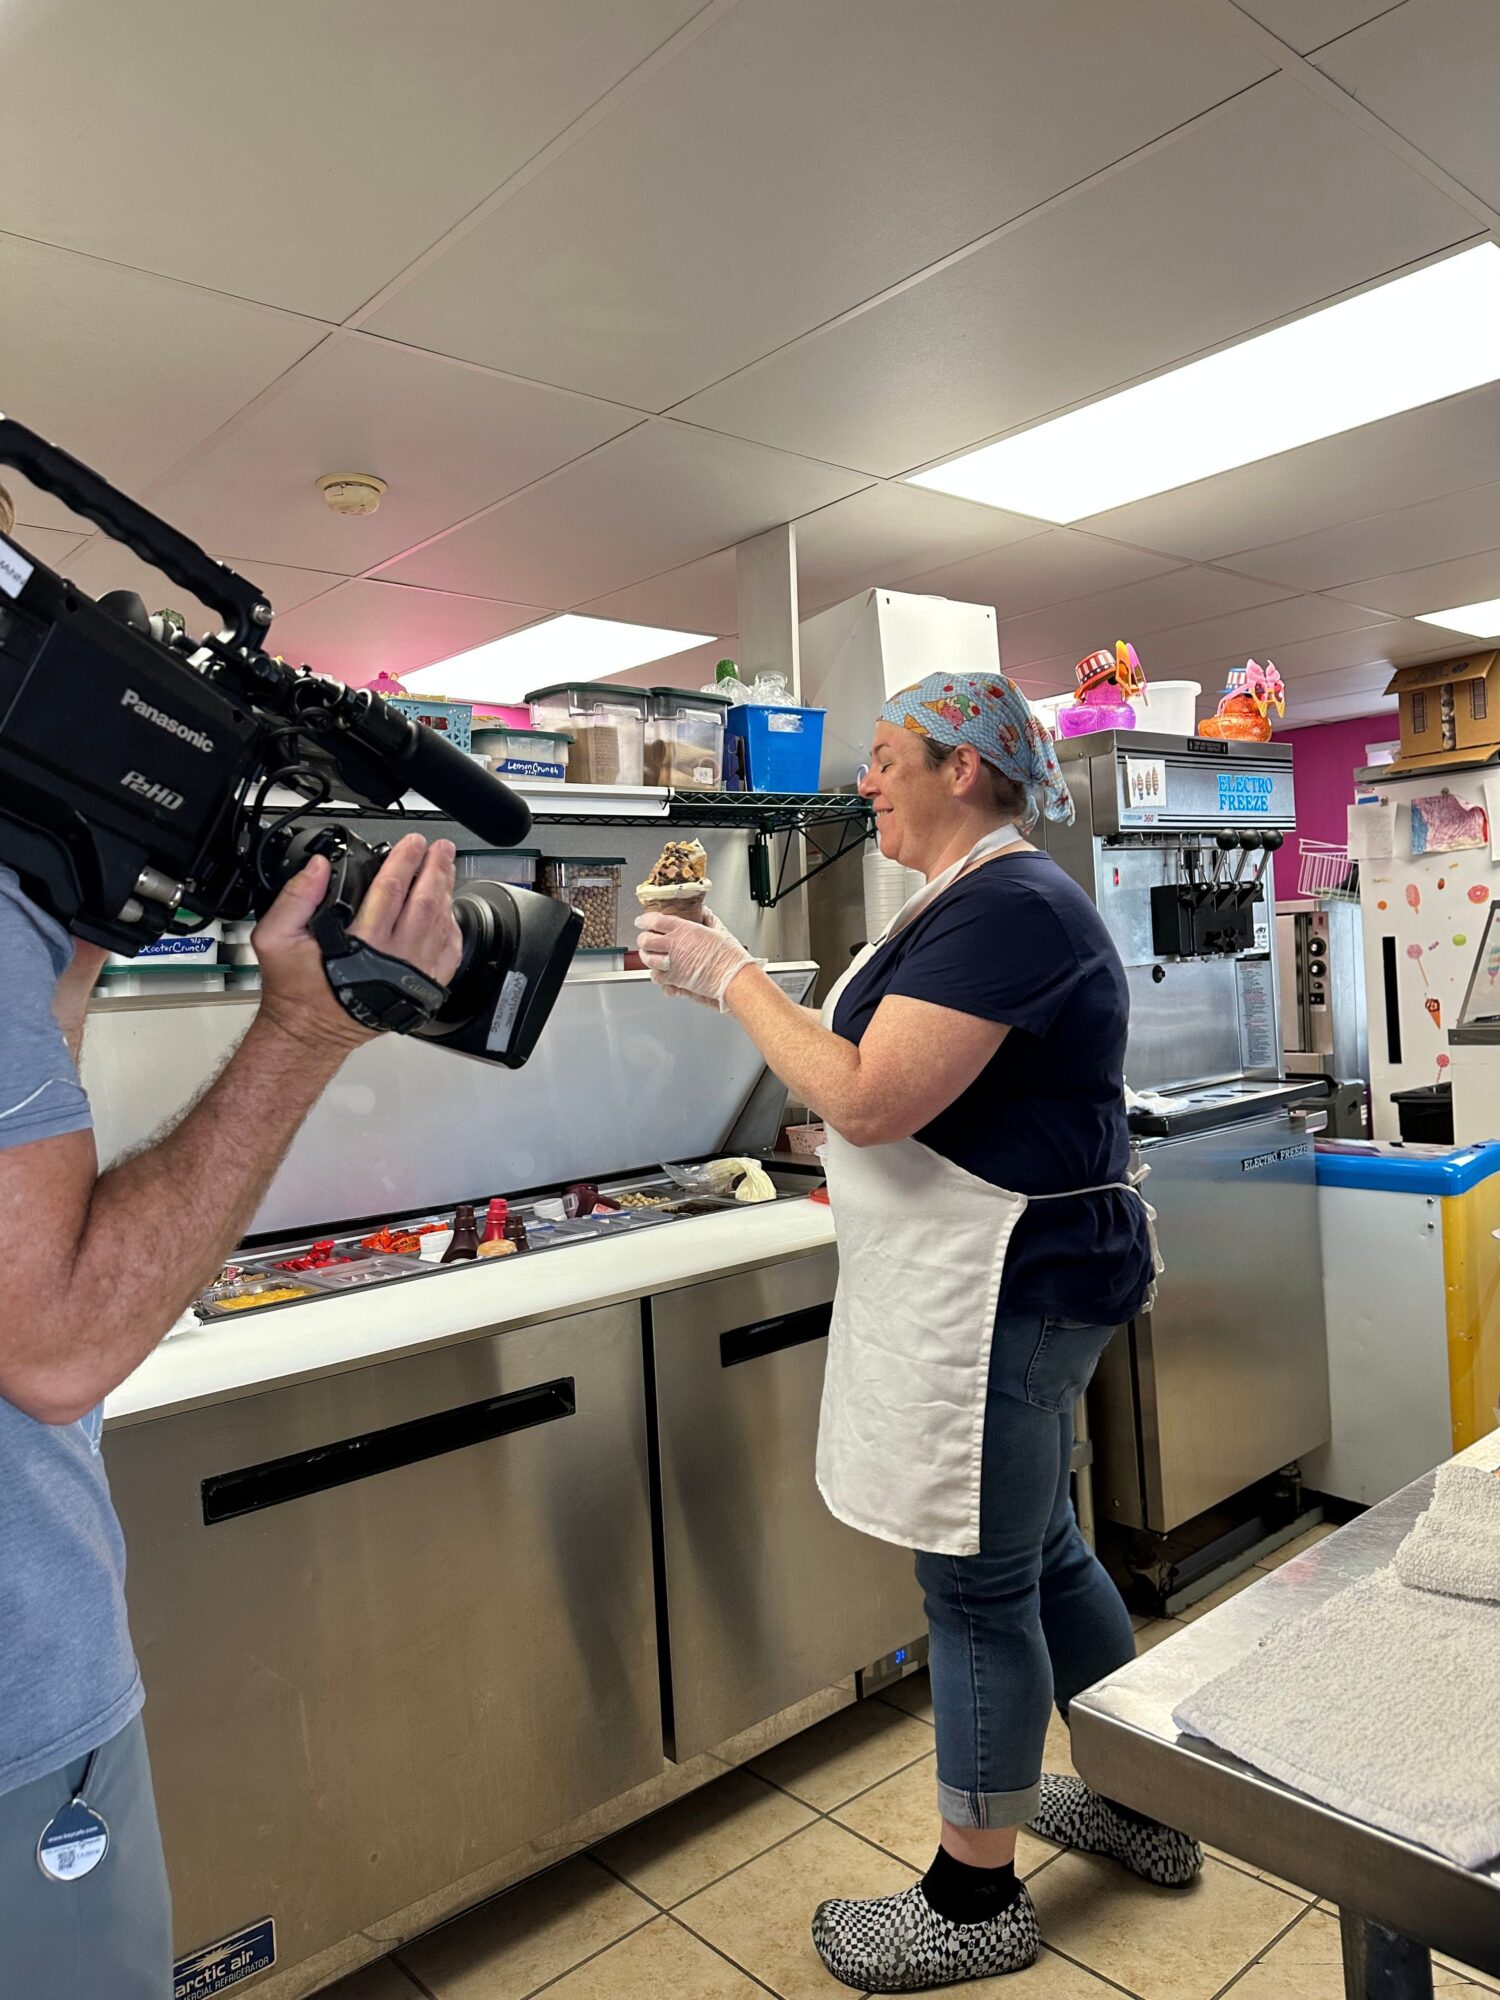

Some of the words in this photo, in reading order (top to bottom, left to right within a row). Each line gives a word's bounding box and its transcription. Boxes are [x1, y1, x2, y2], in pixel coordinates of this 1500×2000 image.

[121, 687, 214, 752] Panasonic
[120, 770, 184, 810] P2HD
[1216, 774, 1274, 794] ELECTRO
[1218, 793, 1269, 812] FREEZE
[1243, 1151, 1278, 1172] ELECTRO
[1279, 1143, 1309, 1161] FREEZE
[175, 1963, 226, 1998] arctic
[230, 1949, 254, 1971] air
[214, 1955, 269, 1991] REFRIGERATOR
